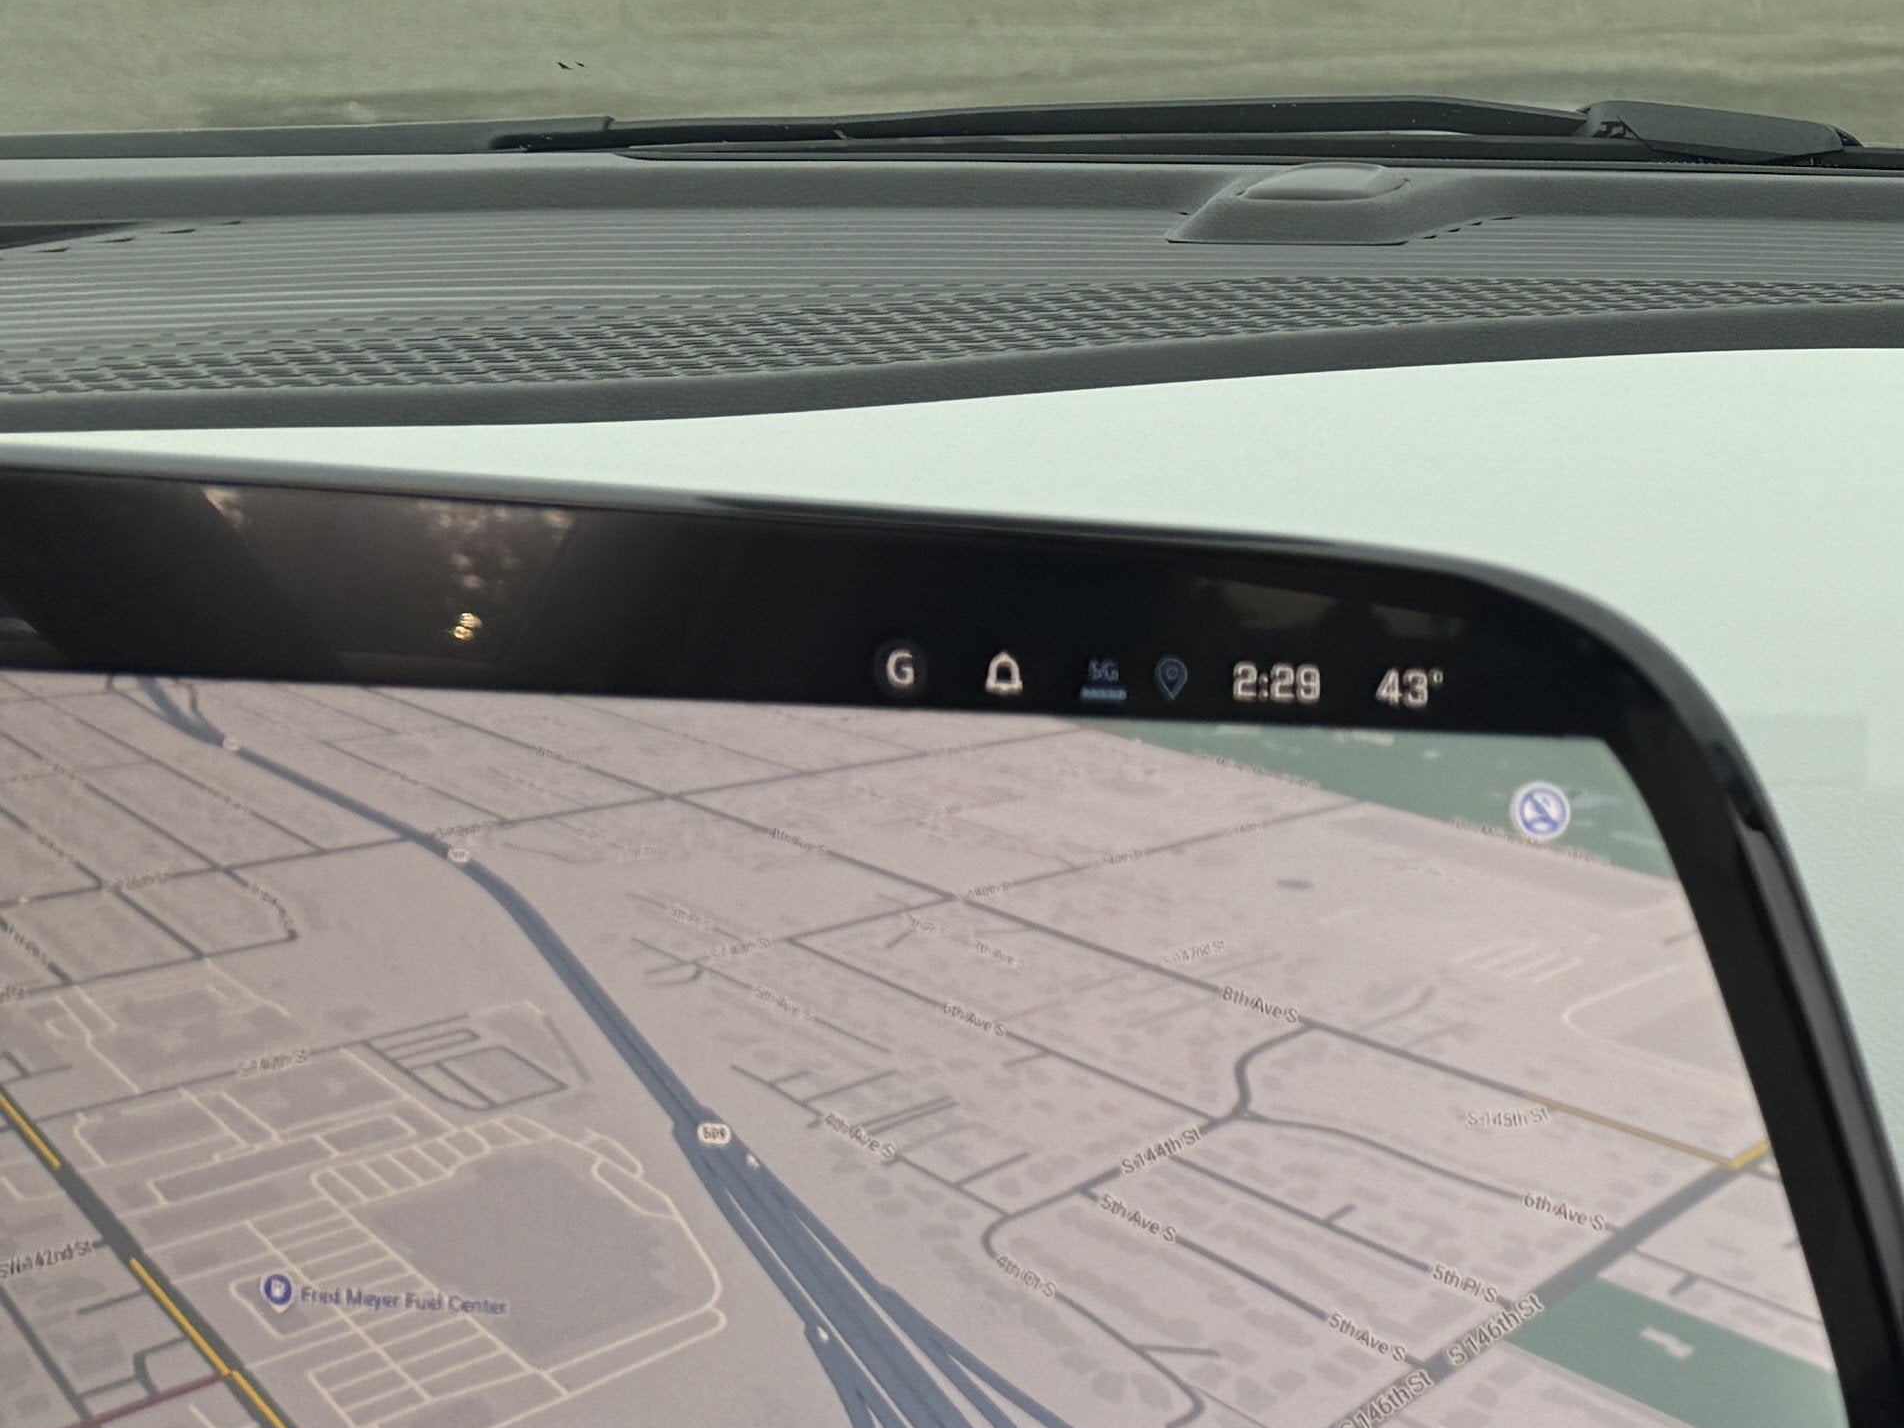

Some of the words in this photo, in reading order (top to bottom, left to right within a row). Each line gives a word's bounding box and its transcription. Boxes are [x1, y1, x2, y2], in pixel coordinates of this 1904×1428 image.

[1233, 660, 1321, 704] 2:29
[1375, 667, 1444, 708] 43°
[1252, 997, 1283, 1019] Ave
[1286, 1008, 1299, 1025] S
[882, 1142, 897, 1160] S
[1122, 1156, 1135, 1174] S
[1136, 1136, 1182, 1170] 144th
[1182, 1127, 1200, 1147] St
[1101, 1192, 1127, 1220] 5th
[1128, 1209, 1160, 1236] Ave
[1162, 1224, 1176, 1243] S
[1524, 1192, 1551, 1214] 6th
[1554, 1202, 1588, 1227] Ave
[1592, 1213, 1605, 1231] S
[996, 1254, 1021, 1279] 4th
[1043, 1280, 1057, 1298] S
[1432, 1263, 1461, 1290] 5th
[1484, 1286, 1499, 1305] S
[448, 1295, 508, 1316] Center
[1329, 1311, 1356, 1338] 5th
[1357, 1328, 1391, 1357] Ave
[1391, 1345, 1407, 1363] S
[1448, 1346, 1467, 1366] S
[1464, 1309, 1521, 1355] 146th
[1518, 1293, 1545, 1319] St
[1407, 1369, 1433, 1394] St
